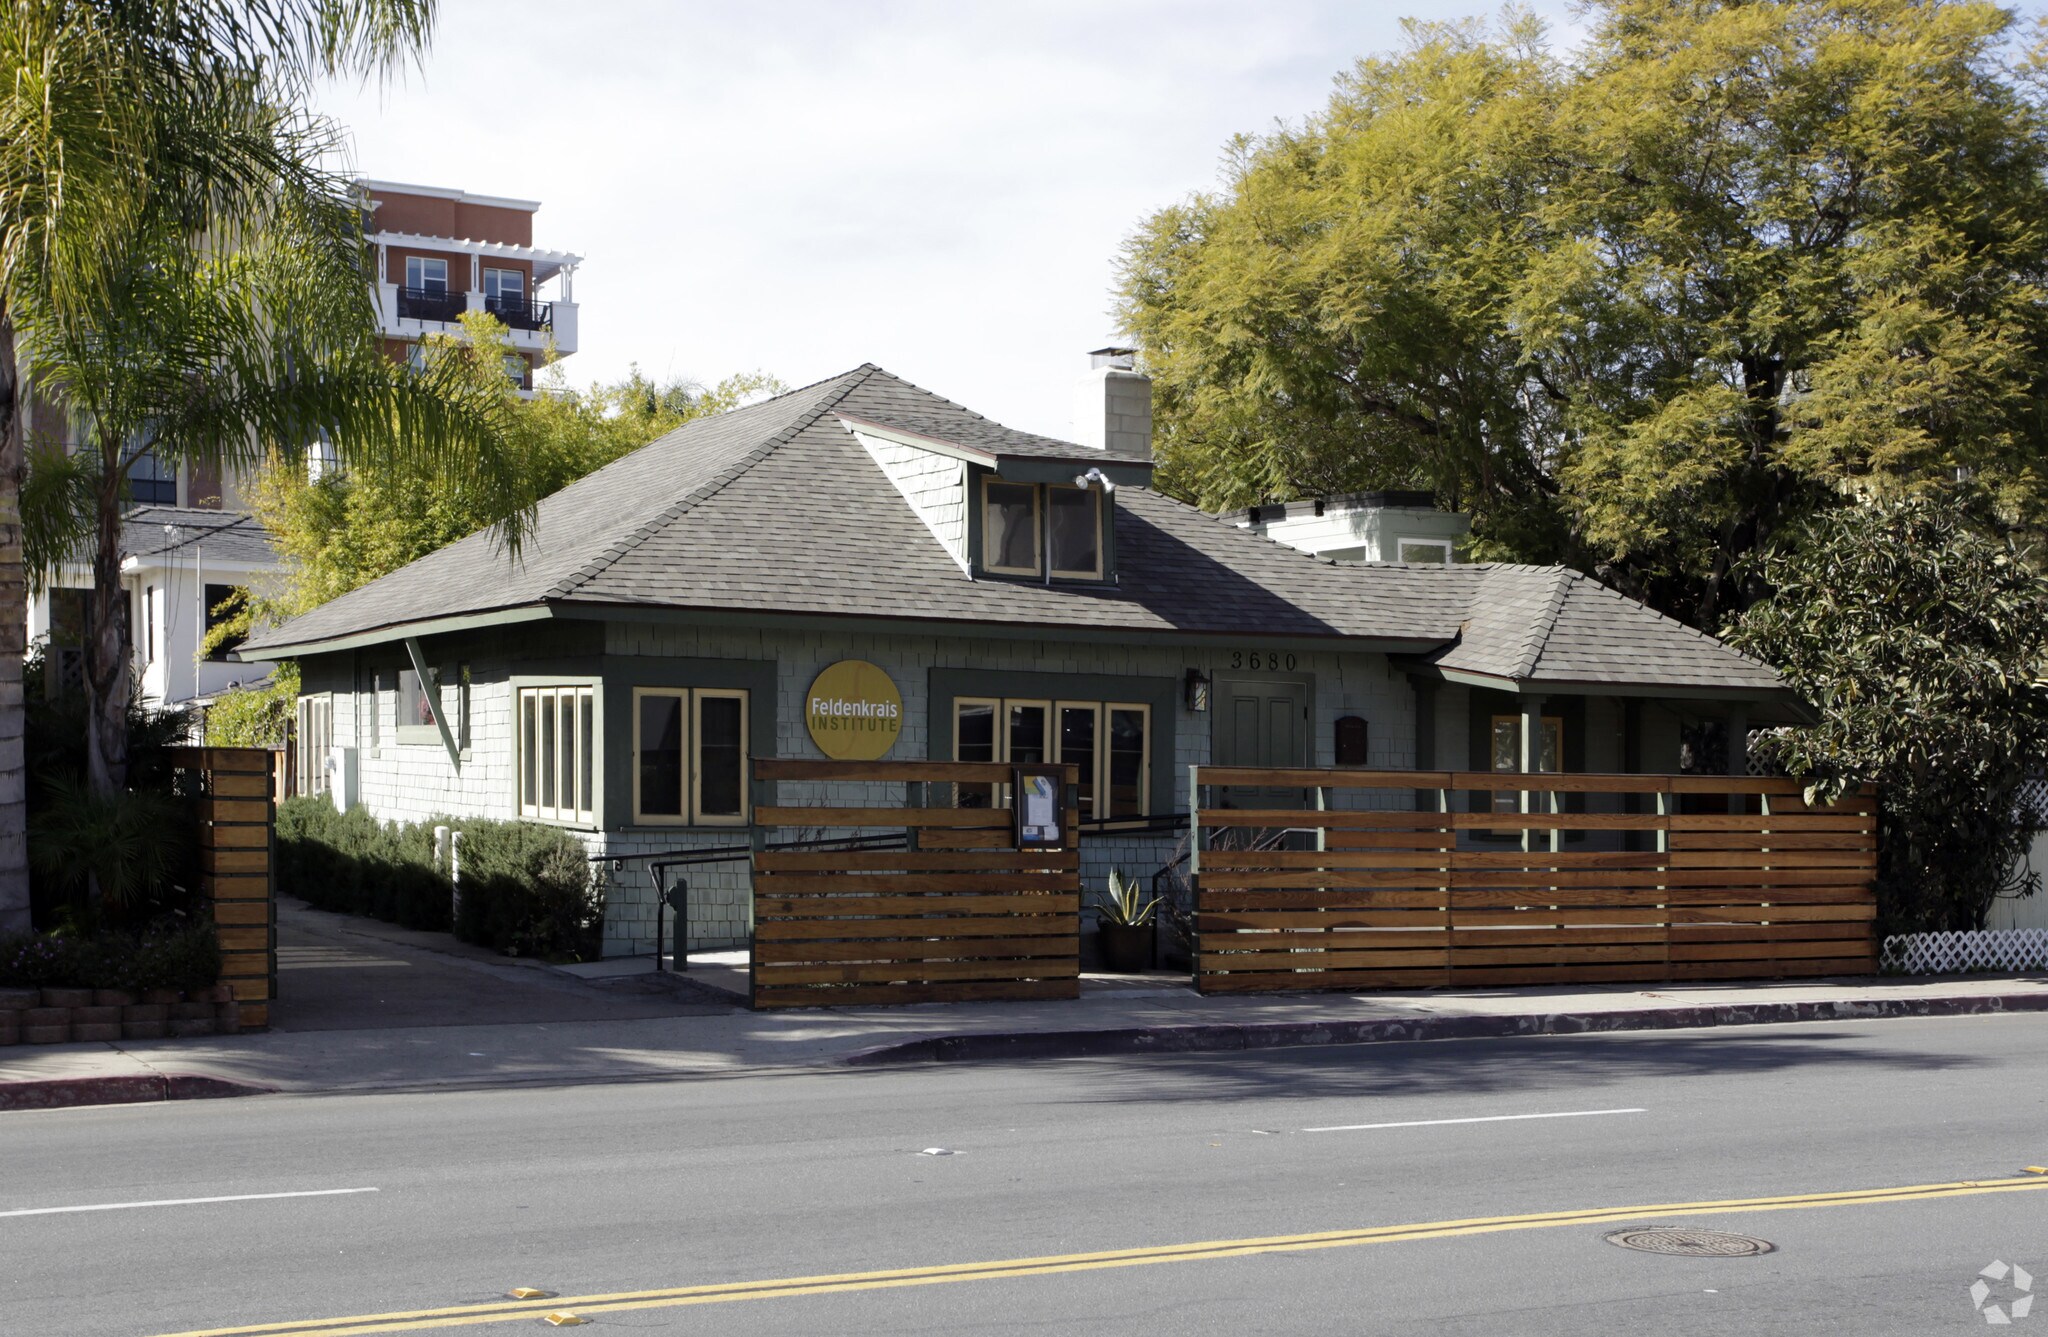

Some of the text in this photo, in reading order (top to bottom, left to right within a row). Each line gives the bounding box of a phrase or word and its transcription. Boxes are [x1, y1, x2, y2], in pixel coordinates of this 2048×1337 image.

[1231, 651, 1296, 671] 3680
[812, 697, 898, 718] Feldenkrais
[811, 716, 897, 732] INSTITUTE
